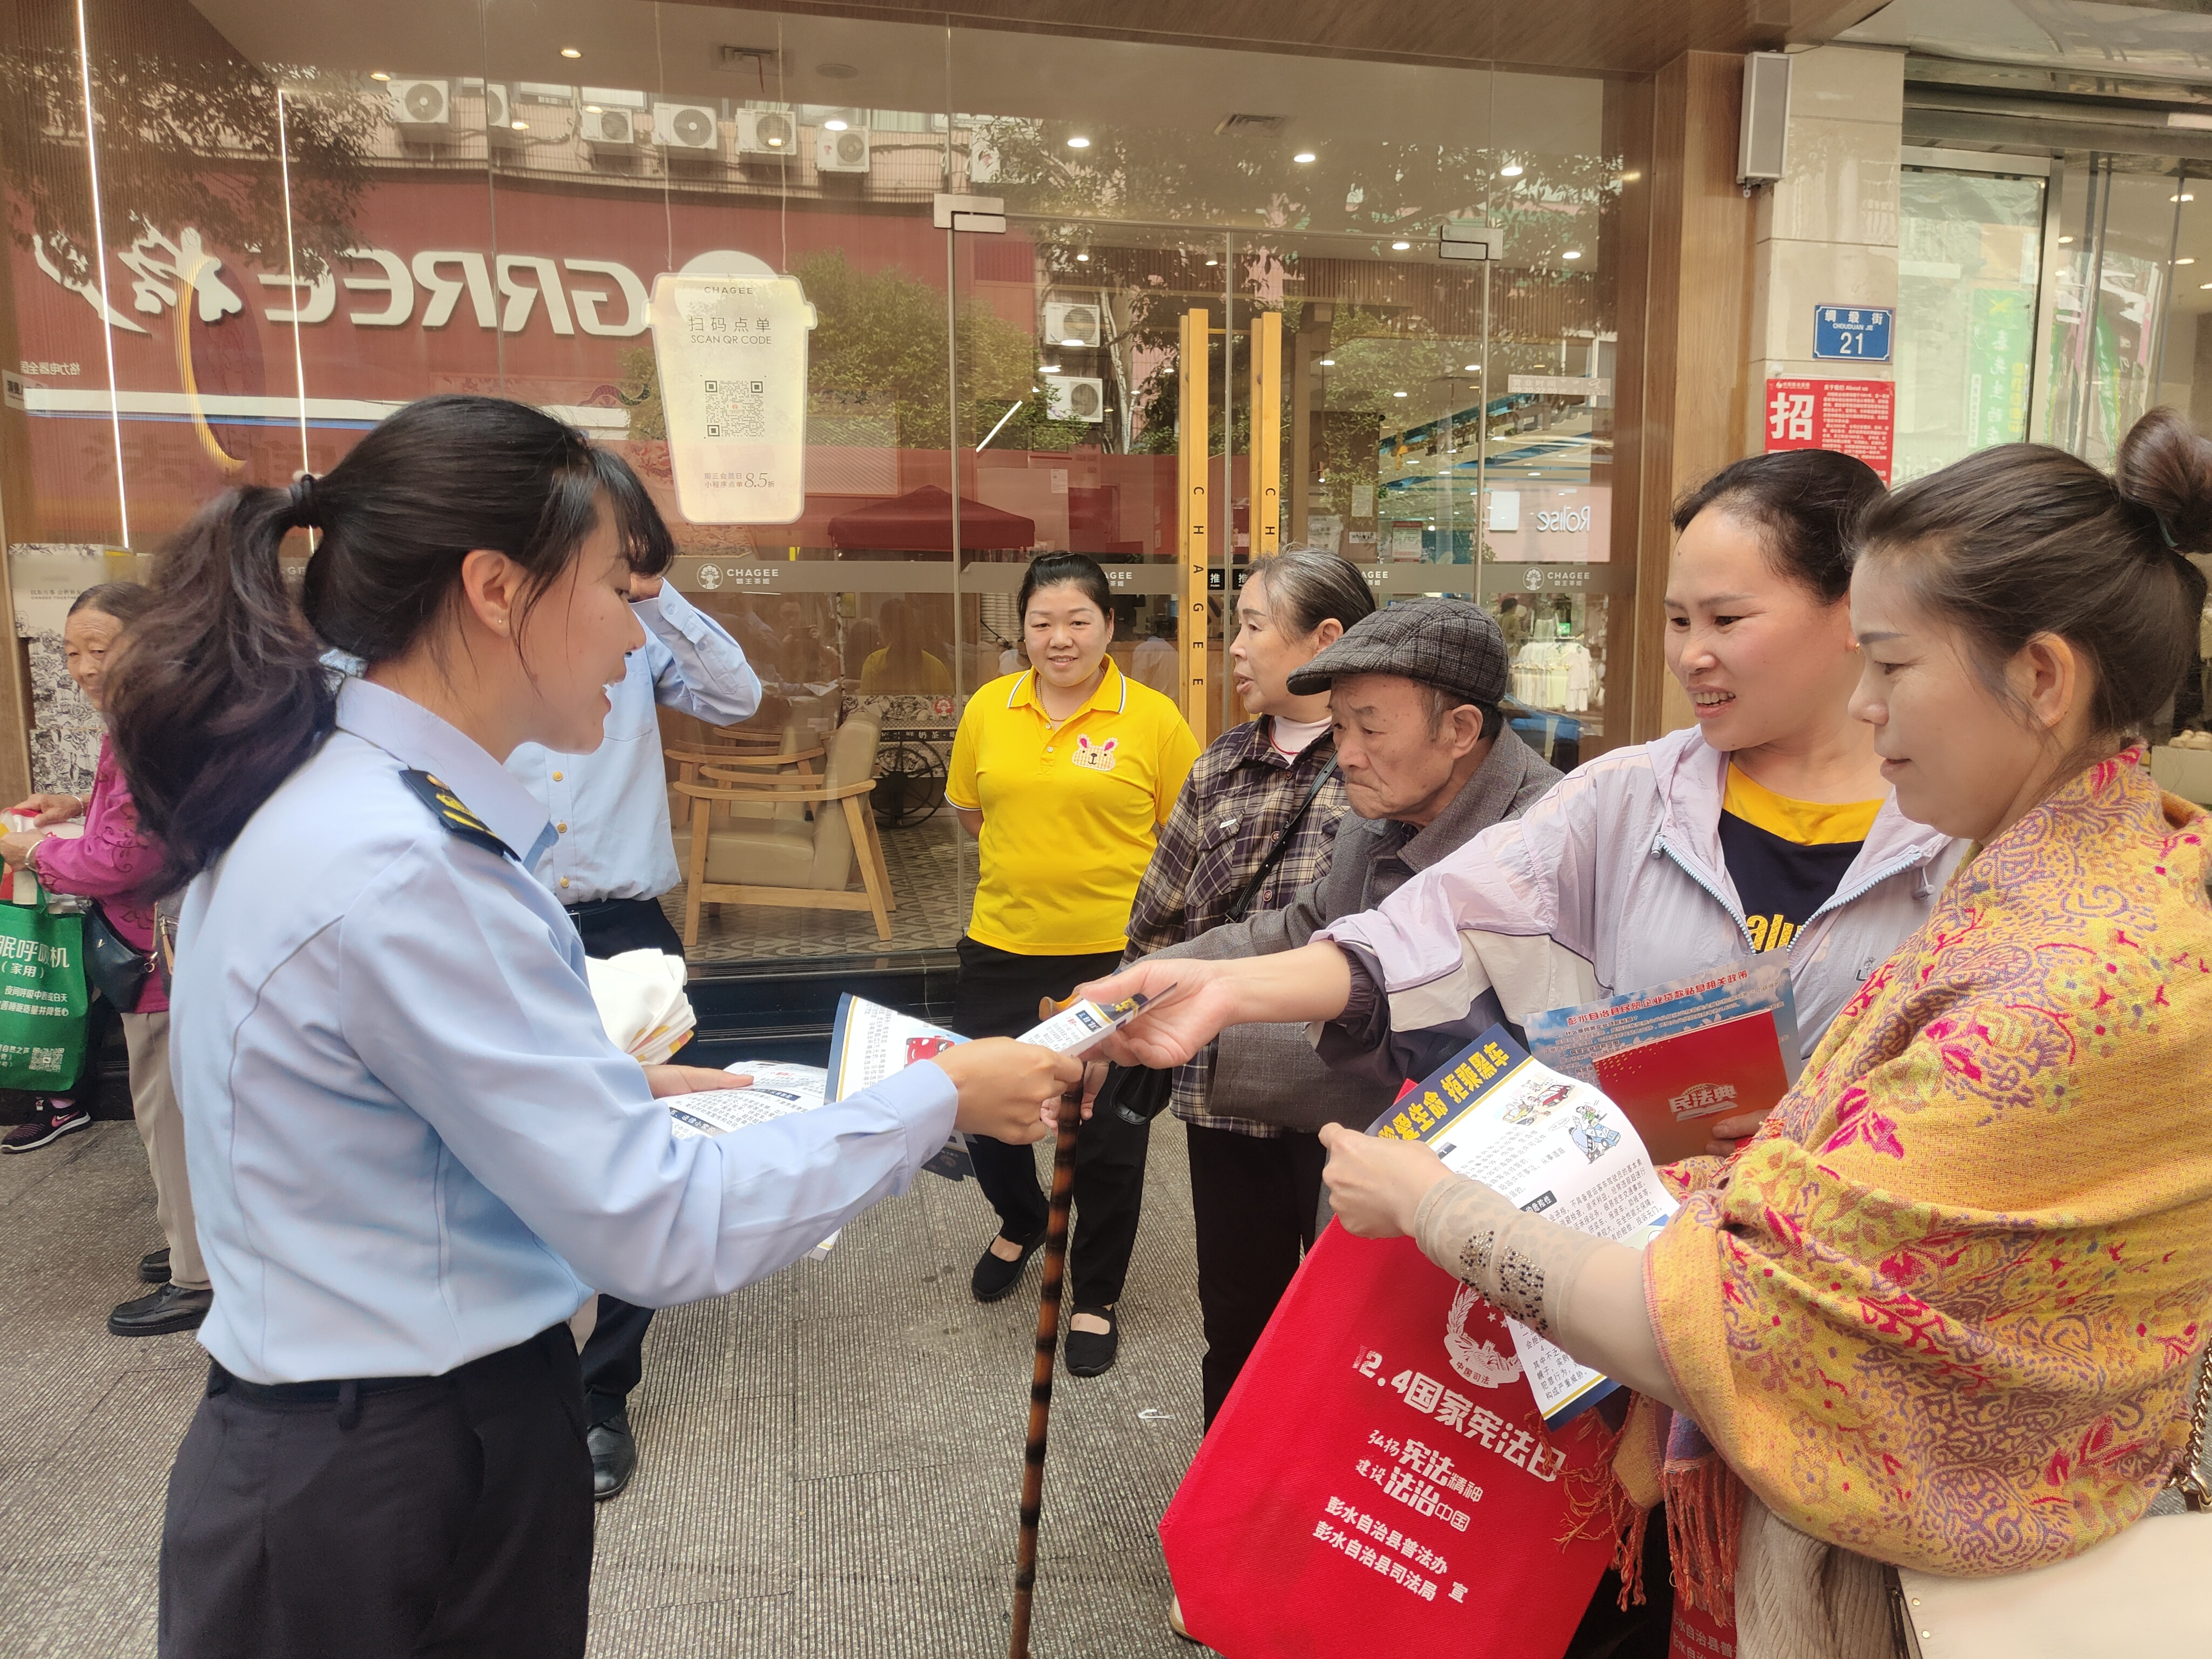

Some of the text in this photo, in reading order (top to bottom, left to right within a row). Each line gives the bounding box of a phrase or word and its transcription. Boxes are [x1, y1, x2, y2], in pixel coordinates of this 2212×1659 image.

[704, 286, 754, 294] CHAGEE
[688, 316, 771, 333] 扫码点单
[691, 335, 772, 345] SCAN QR CODE
[1839, 332, 1863, 354] 21
[1513, 379, 1556, 387] 营业时间
[1769, 392, 1815, 440] 招
[727, 569, 779, 577] CHAGEE
[1210, 573, 1220, 584] 推
[1547, 571, 1590, 579] CHAGEE
[1440, 1041, 1510, 1104] 拒乘黑车
[1671, 1084, 1737, 1112] 民法典
[1454, 1360, 1492, 1385] 中国司法
[1368, 1428, 1484, 1503] 弘扬宪法精神
[1355, 1458, 1471, 1533] 建设法治中国
[1325, 1495, 1448, 1575] 彭水自治县普法办
[1312, 1520, 1438, 1602] 彭水自治县司法局
[1449, 1581, 1469, 1604] 宣
